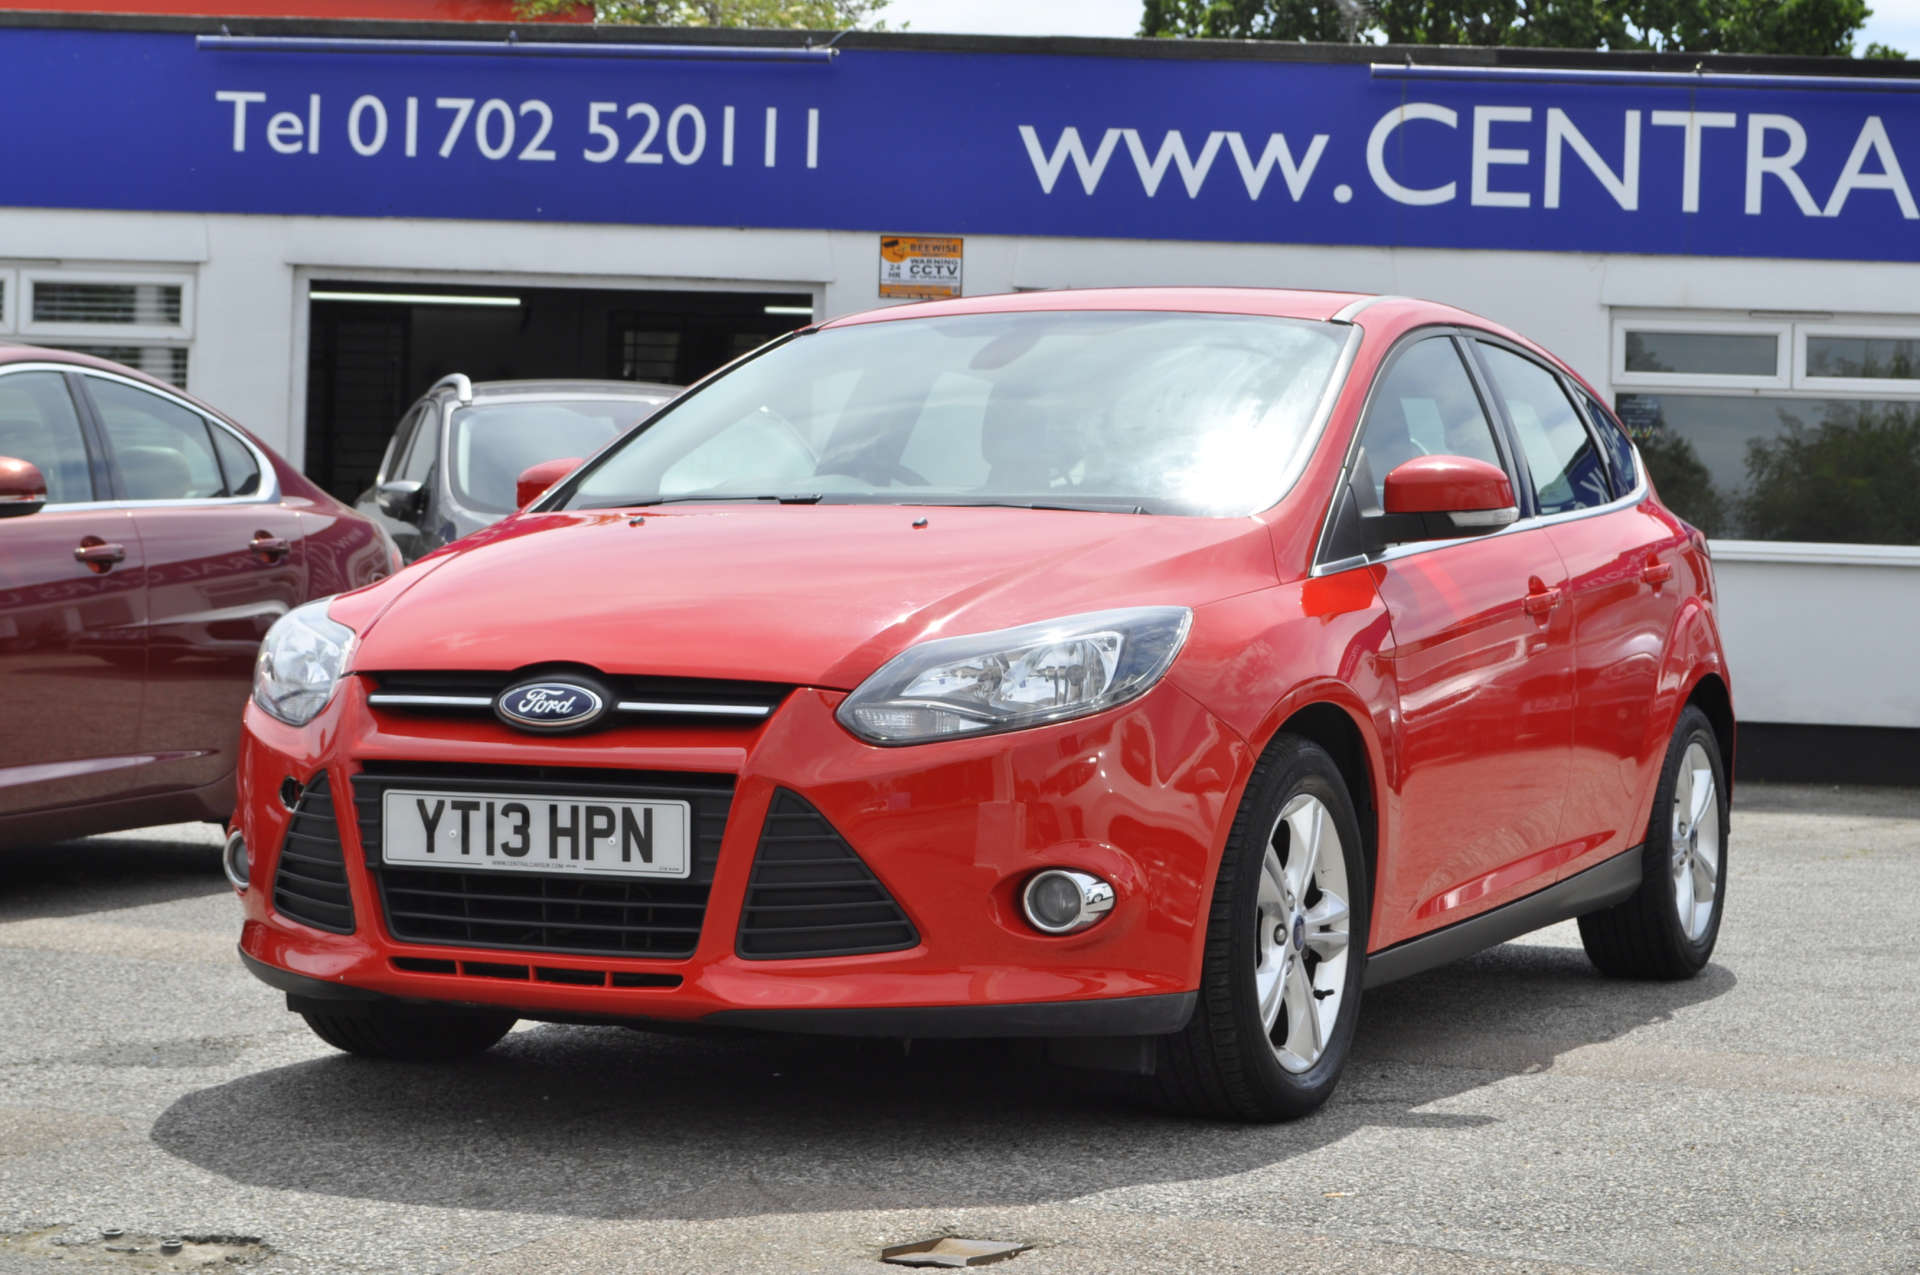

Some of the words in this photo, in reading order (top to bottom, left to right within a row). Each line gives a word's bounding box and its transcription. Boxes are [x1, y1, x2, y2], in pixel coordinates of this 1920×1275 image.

[216, 91, 320, 153] Tel
[349, 95, 555, 160] 01702
[584, 103, 818, 168] 520111
[909, 265, 958, 275] CCTV
[518, 688, 576, 714] Ford
[416, 799, 531, 857] YT13
[549, 803, 653, 863] HPN
